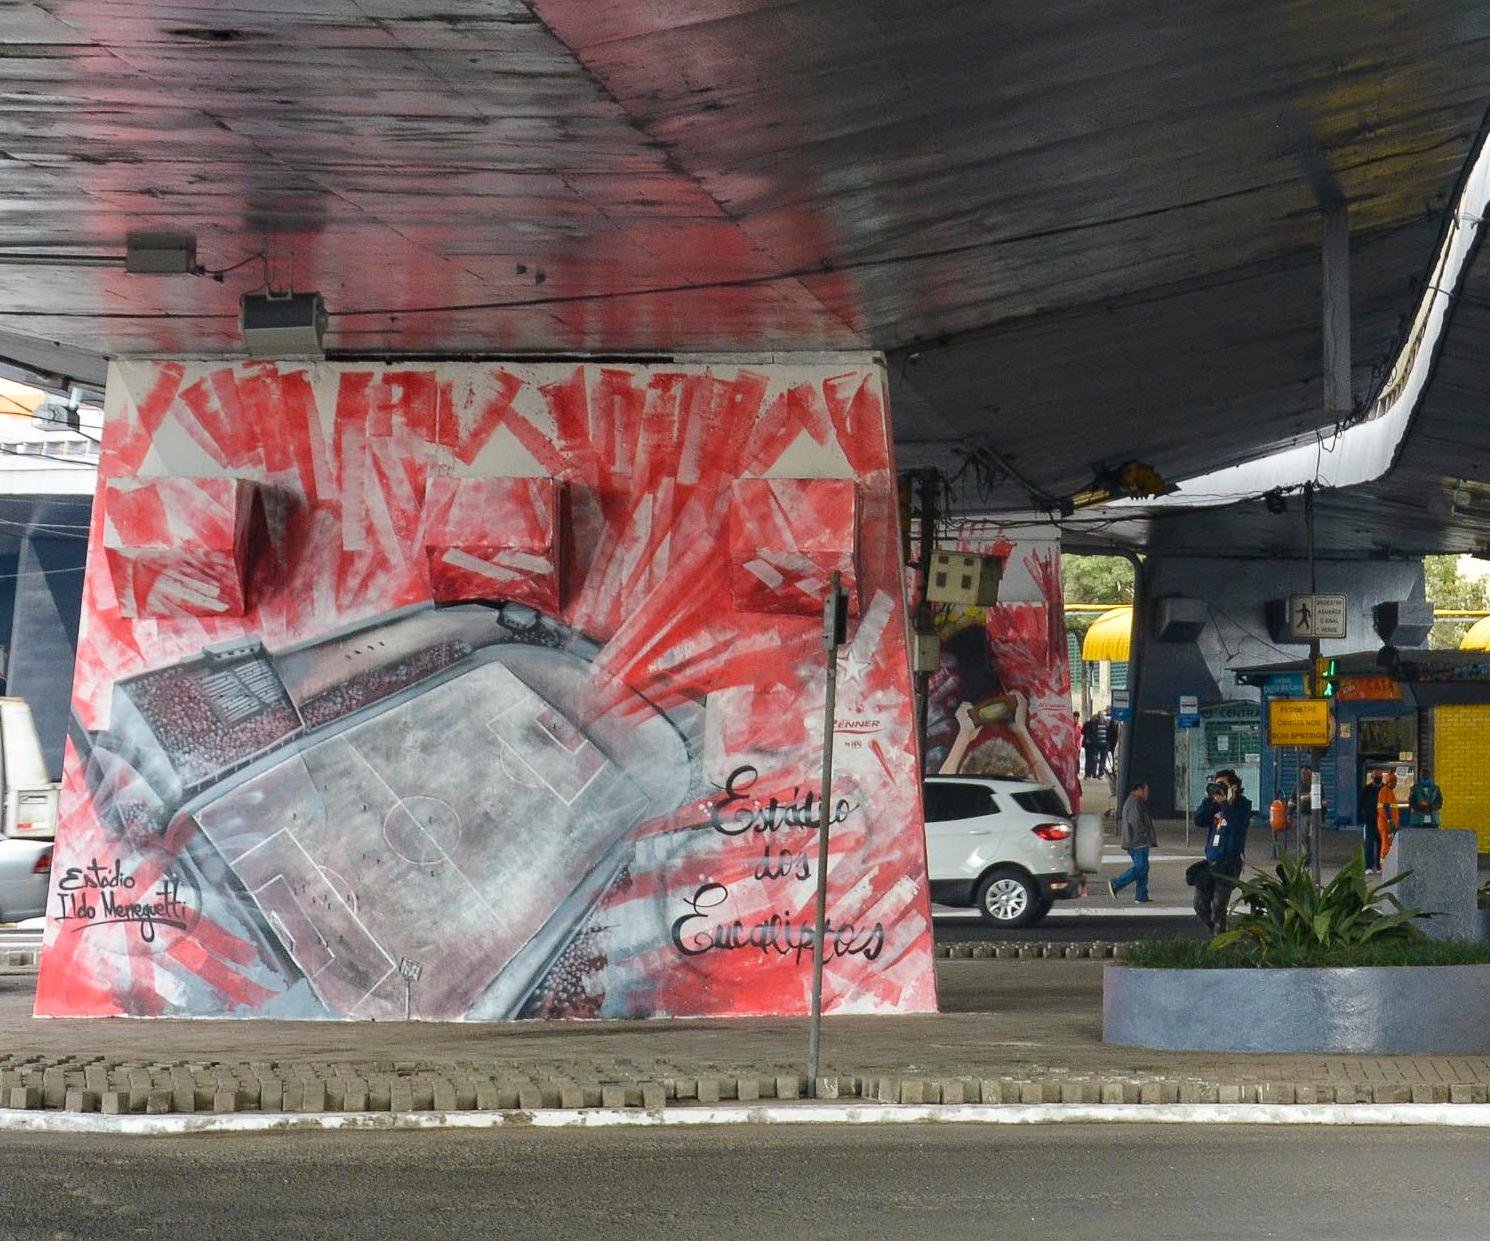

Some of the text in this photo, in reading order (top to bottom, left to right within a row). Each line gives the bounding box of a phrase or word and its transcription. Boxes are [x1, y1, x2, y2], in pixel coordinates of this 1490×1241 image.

[58, 857, 136, 891] Estádio
[754, 846, 811, 881] dos
[54, 892, 96, 921] Ildo
